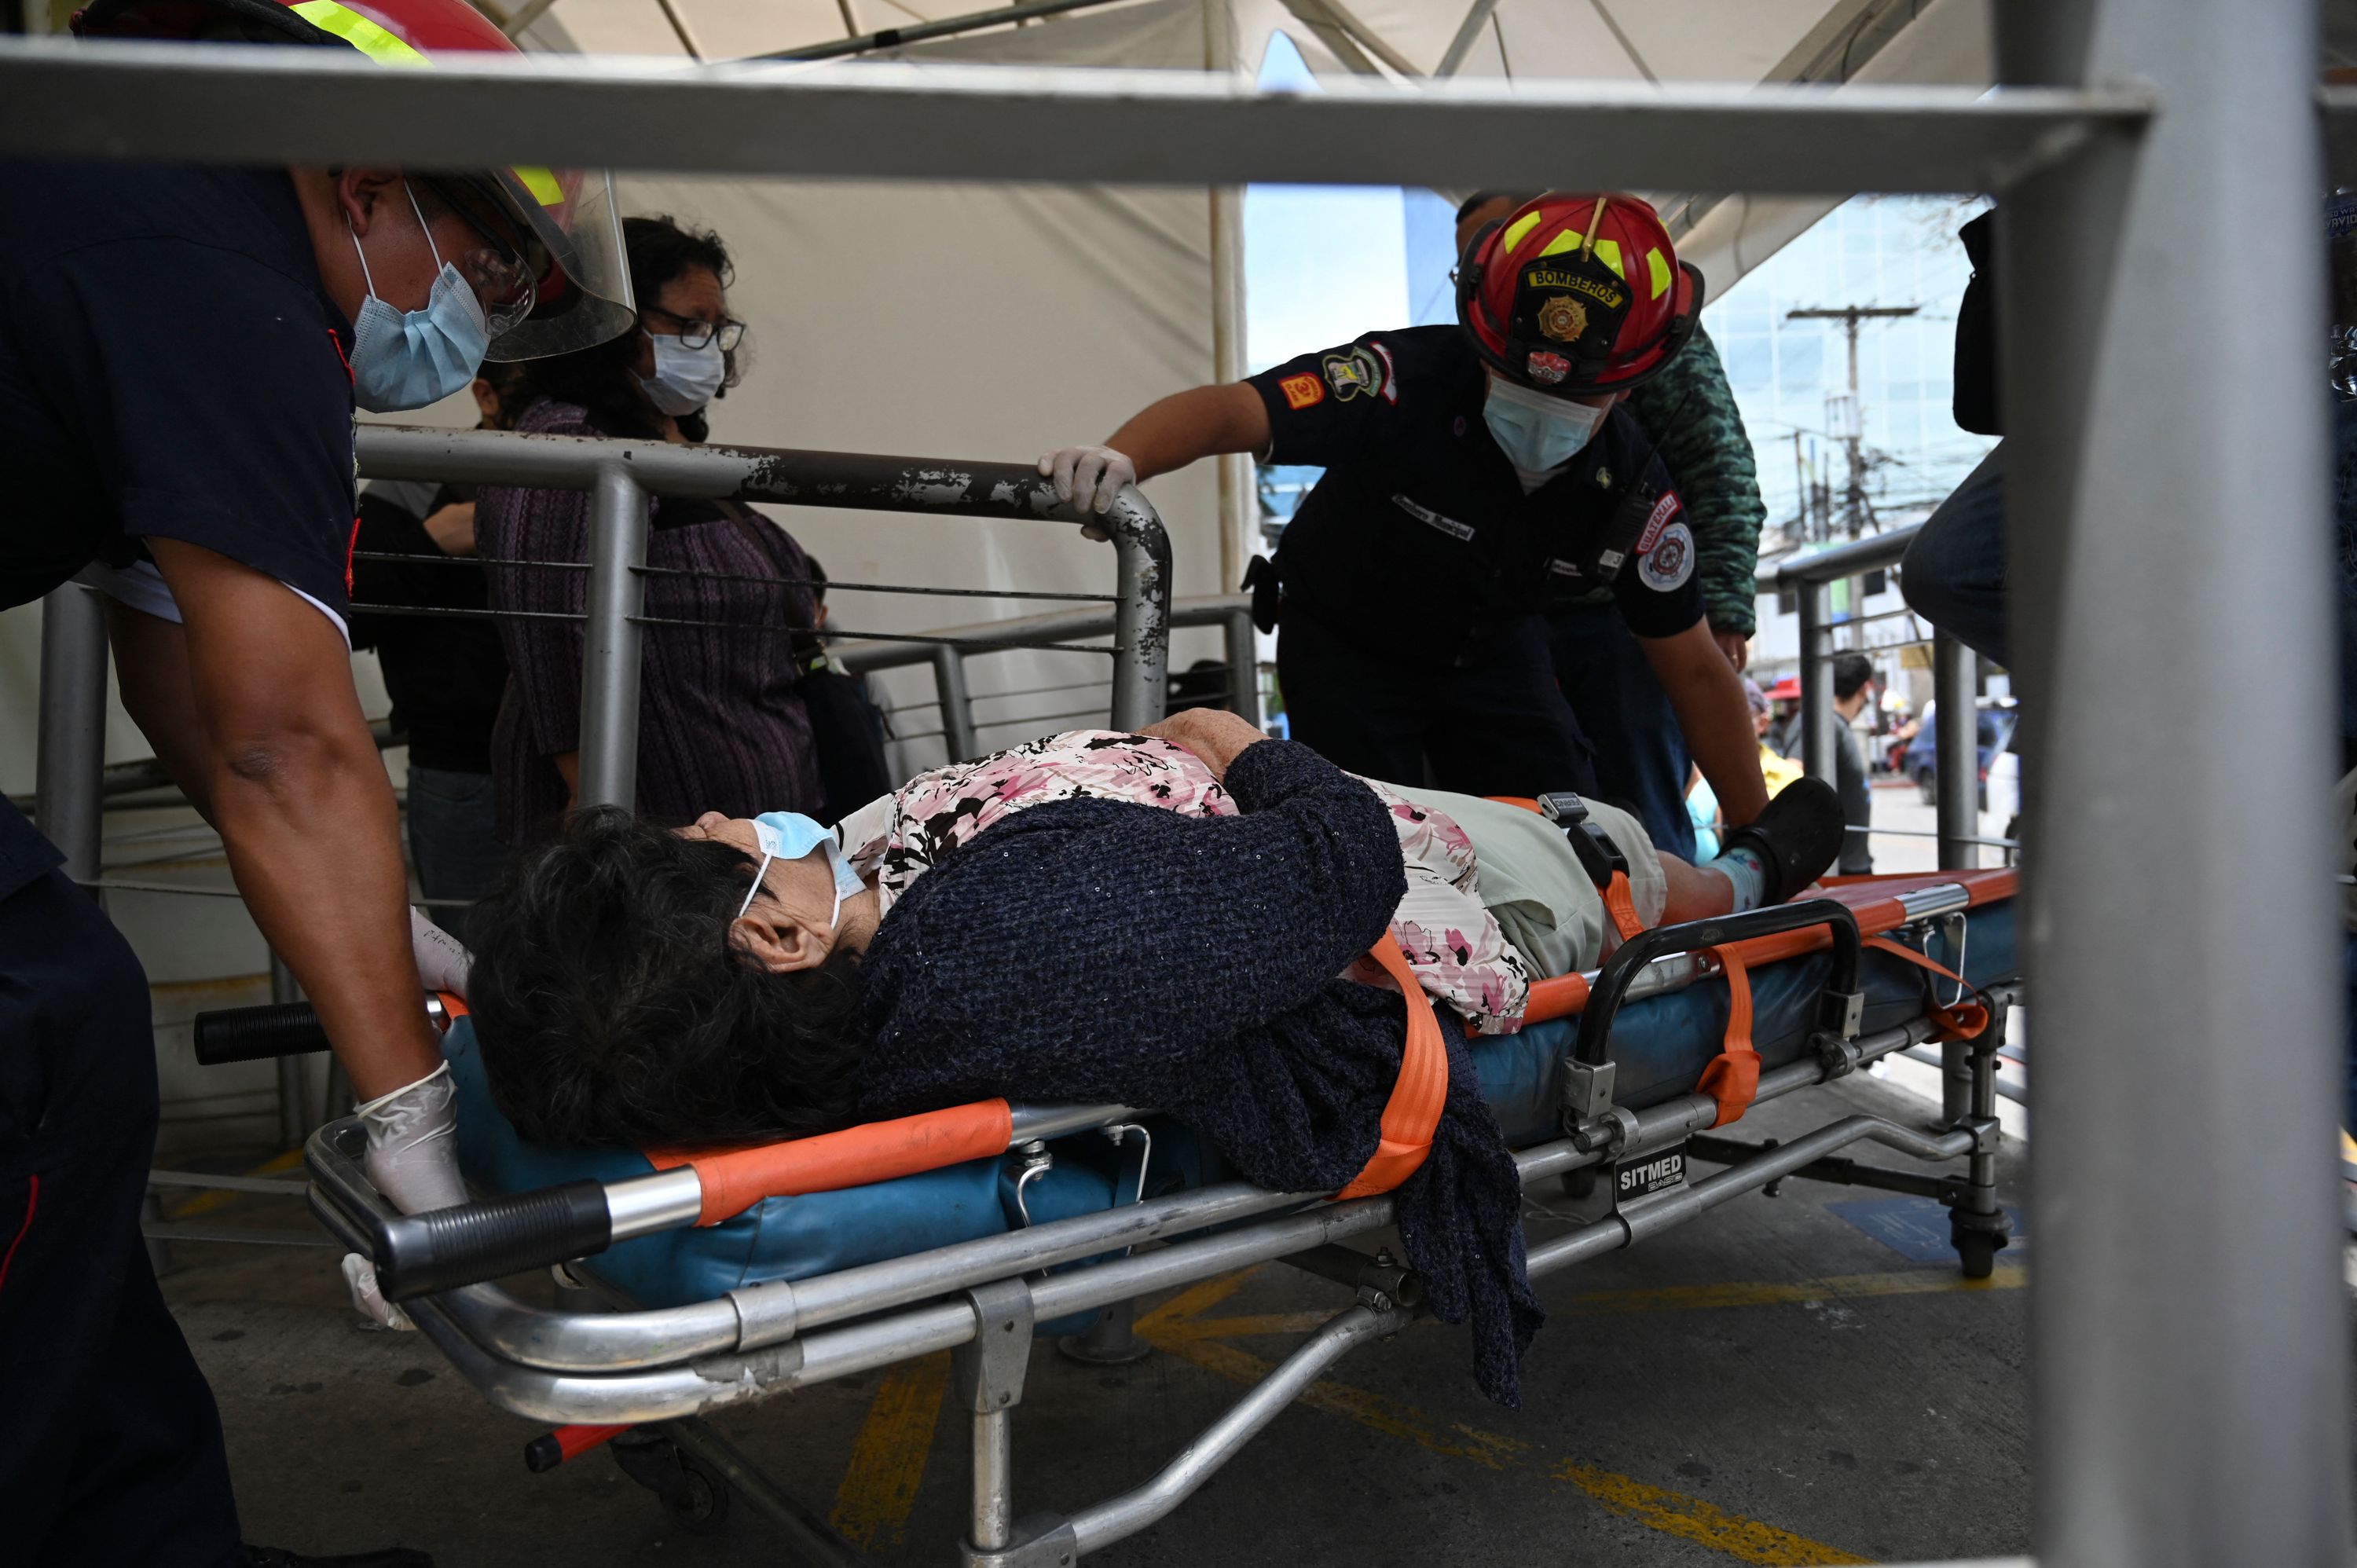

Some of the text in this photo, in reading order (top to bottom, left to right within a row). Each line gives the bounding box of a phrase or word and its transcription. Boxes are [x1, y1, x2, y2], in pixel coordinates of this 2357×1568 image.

[1535, 272, 1617, 302] BOMBEROS
[1621, 1155, 1682, 1190] SITMED
[1648, 1173, 1683, 1192] BASIC
